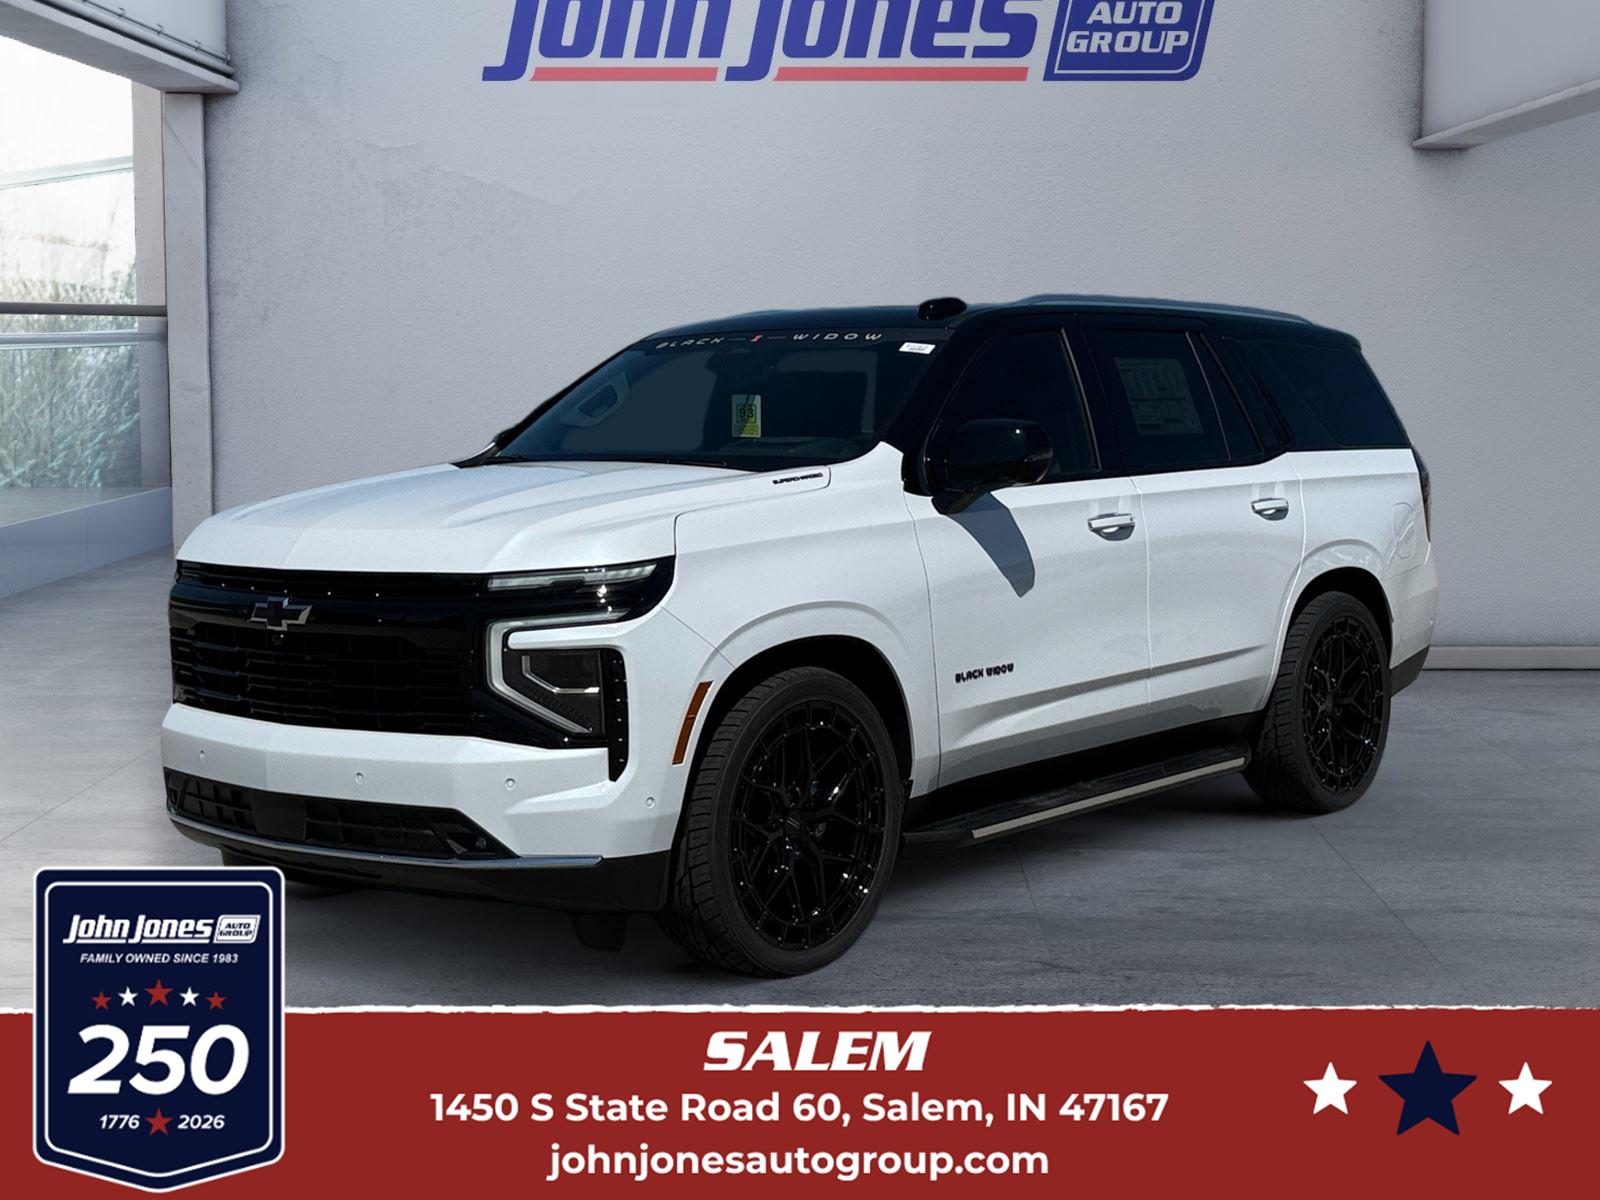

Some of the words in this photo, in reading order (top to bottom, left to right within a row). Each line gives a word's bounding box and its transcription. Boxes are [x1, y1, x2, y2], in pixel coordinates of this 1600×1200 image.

[1086, 0, 1182, 25] AUTO
[481, 0, 718, 81] John
[725, 0, 1039, 81] Jones
[1065, 30, 1190, 55] GROUP
[655, 336, 725, 350] BLACK
[792, 332, 883, 342] WIDOW
[955, 668, 984, 683] BLACK
[986, 662, 1014, 676] WIDOW
